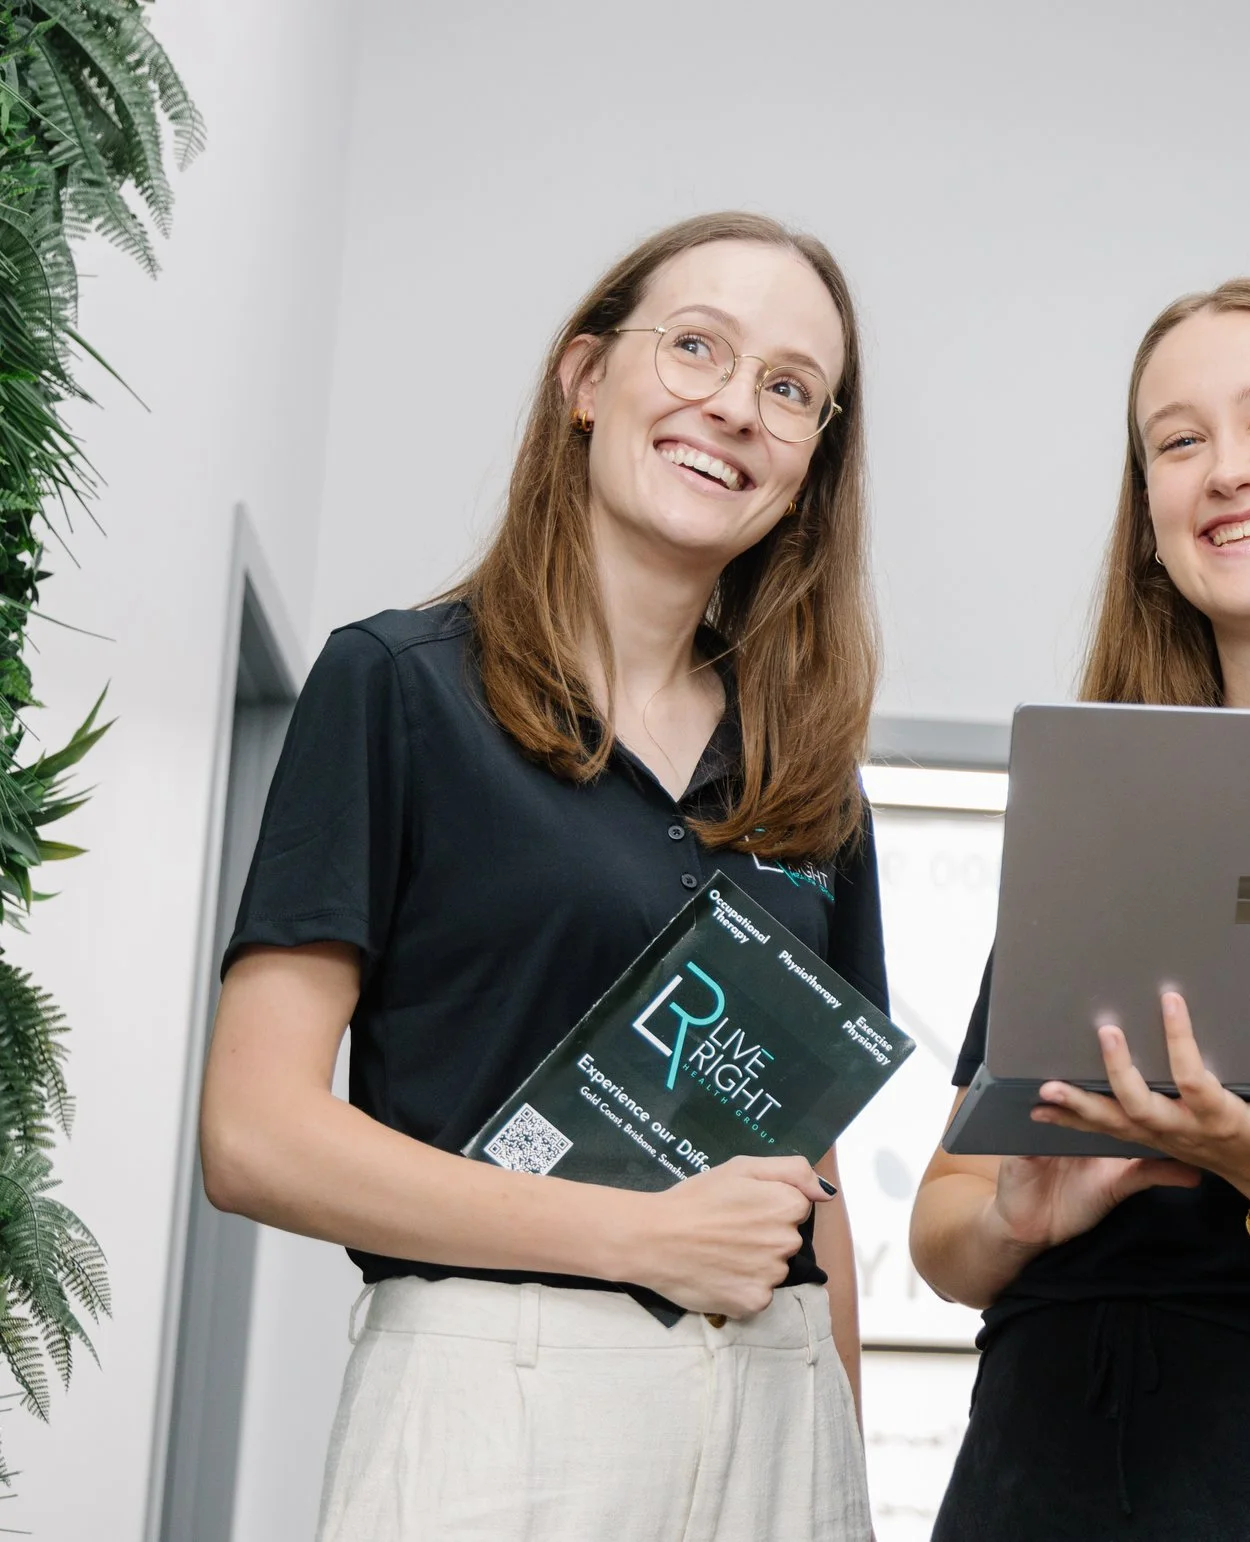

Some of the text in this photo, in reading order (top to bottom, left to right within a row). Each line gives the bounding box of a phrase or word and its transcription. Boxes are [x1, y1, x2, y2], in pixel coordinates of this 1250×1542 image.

[708, 888, 772, 945] Occupational
[711, 906, 751, 945] Therapy
[778, 949, 843, 1010] Physiotherapy
[708, 1016, 775, 1080] LIVE
[842, 1019, 892, 1067] Physiology
[855, 1015, 894, 1052] Exercise
[576, 1052, 651, 1123] Experience
[651, 1121, 677, 1144] our
[682, 1063, 776, 1145] HEALTH GROUP
[687, 1039, 783, 1121] RIGHT
[579, 1086, 603, 1107] Gold
[599, 1102, 624, 1129] Coast,
[622, 1122, 658, 1158] Brisbane,
